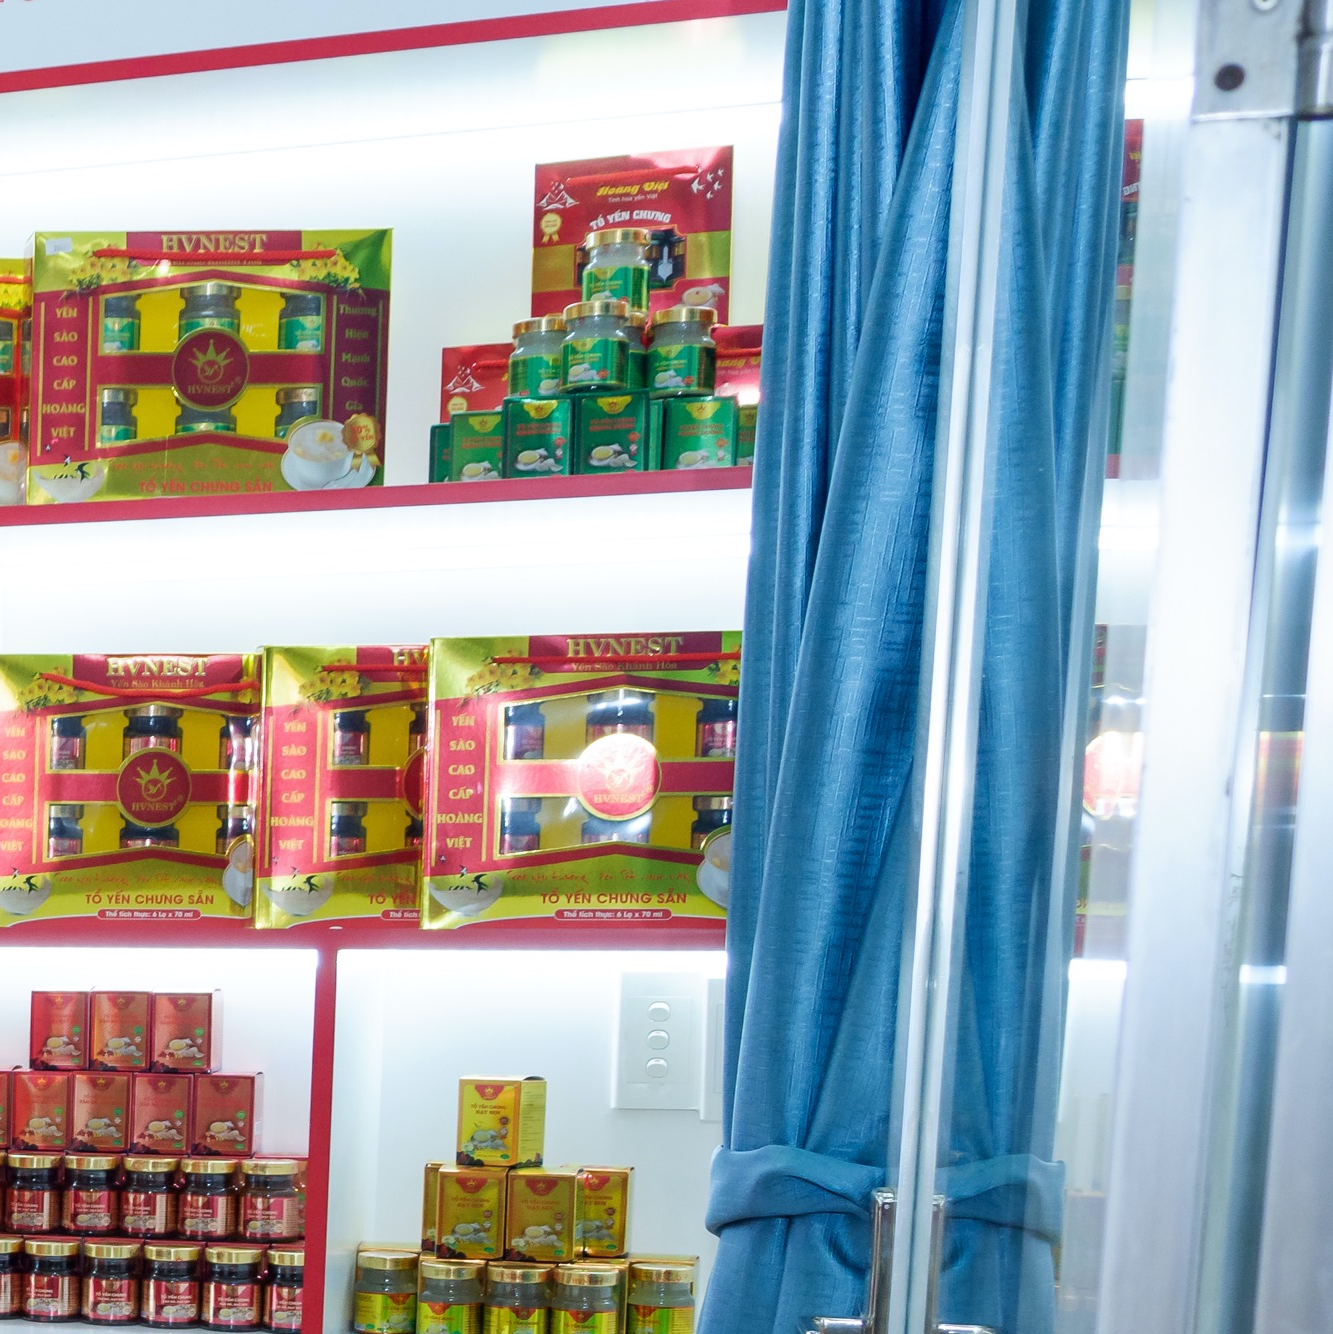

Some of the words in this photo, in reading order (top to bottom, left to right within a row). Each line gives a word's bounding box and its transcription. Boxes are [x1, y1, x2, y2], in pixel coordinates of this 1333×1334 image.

[161, 234, 268, 253] HVNEST
[567, 637, 684, 657] HVNEST
[106, 657, 209, 677] HVNEST
[450, 712, 475, 727] YẾN
[449, 738, 476, 751] SÀO
[448, 764, 475, 776] CAO
[448, 787, 474, 800] CẤP
[437, 812, 483, 824] HOÀNG
[135, 894, 184, 905] CHƯNG
[564, 889, 591, 904] YẾN
[597, 892, 652, 904] CHƯNG
